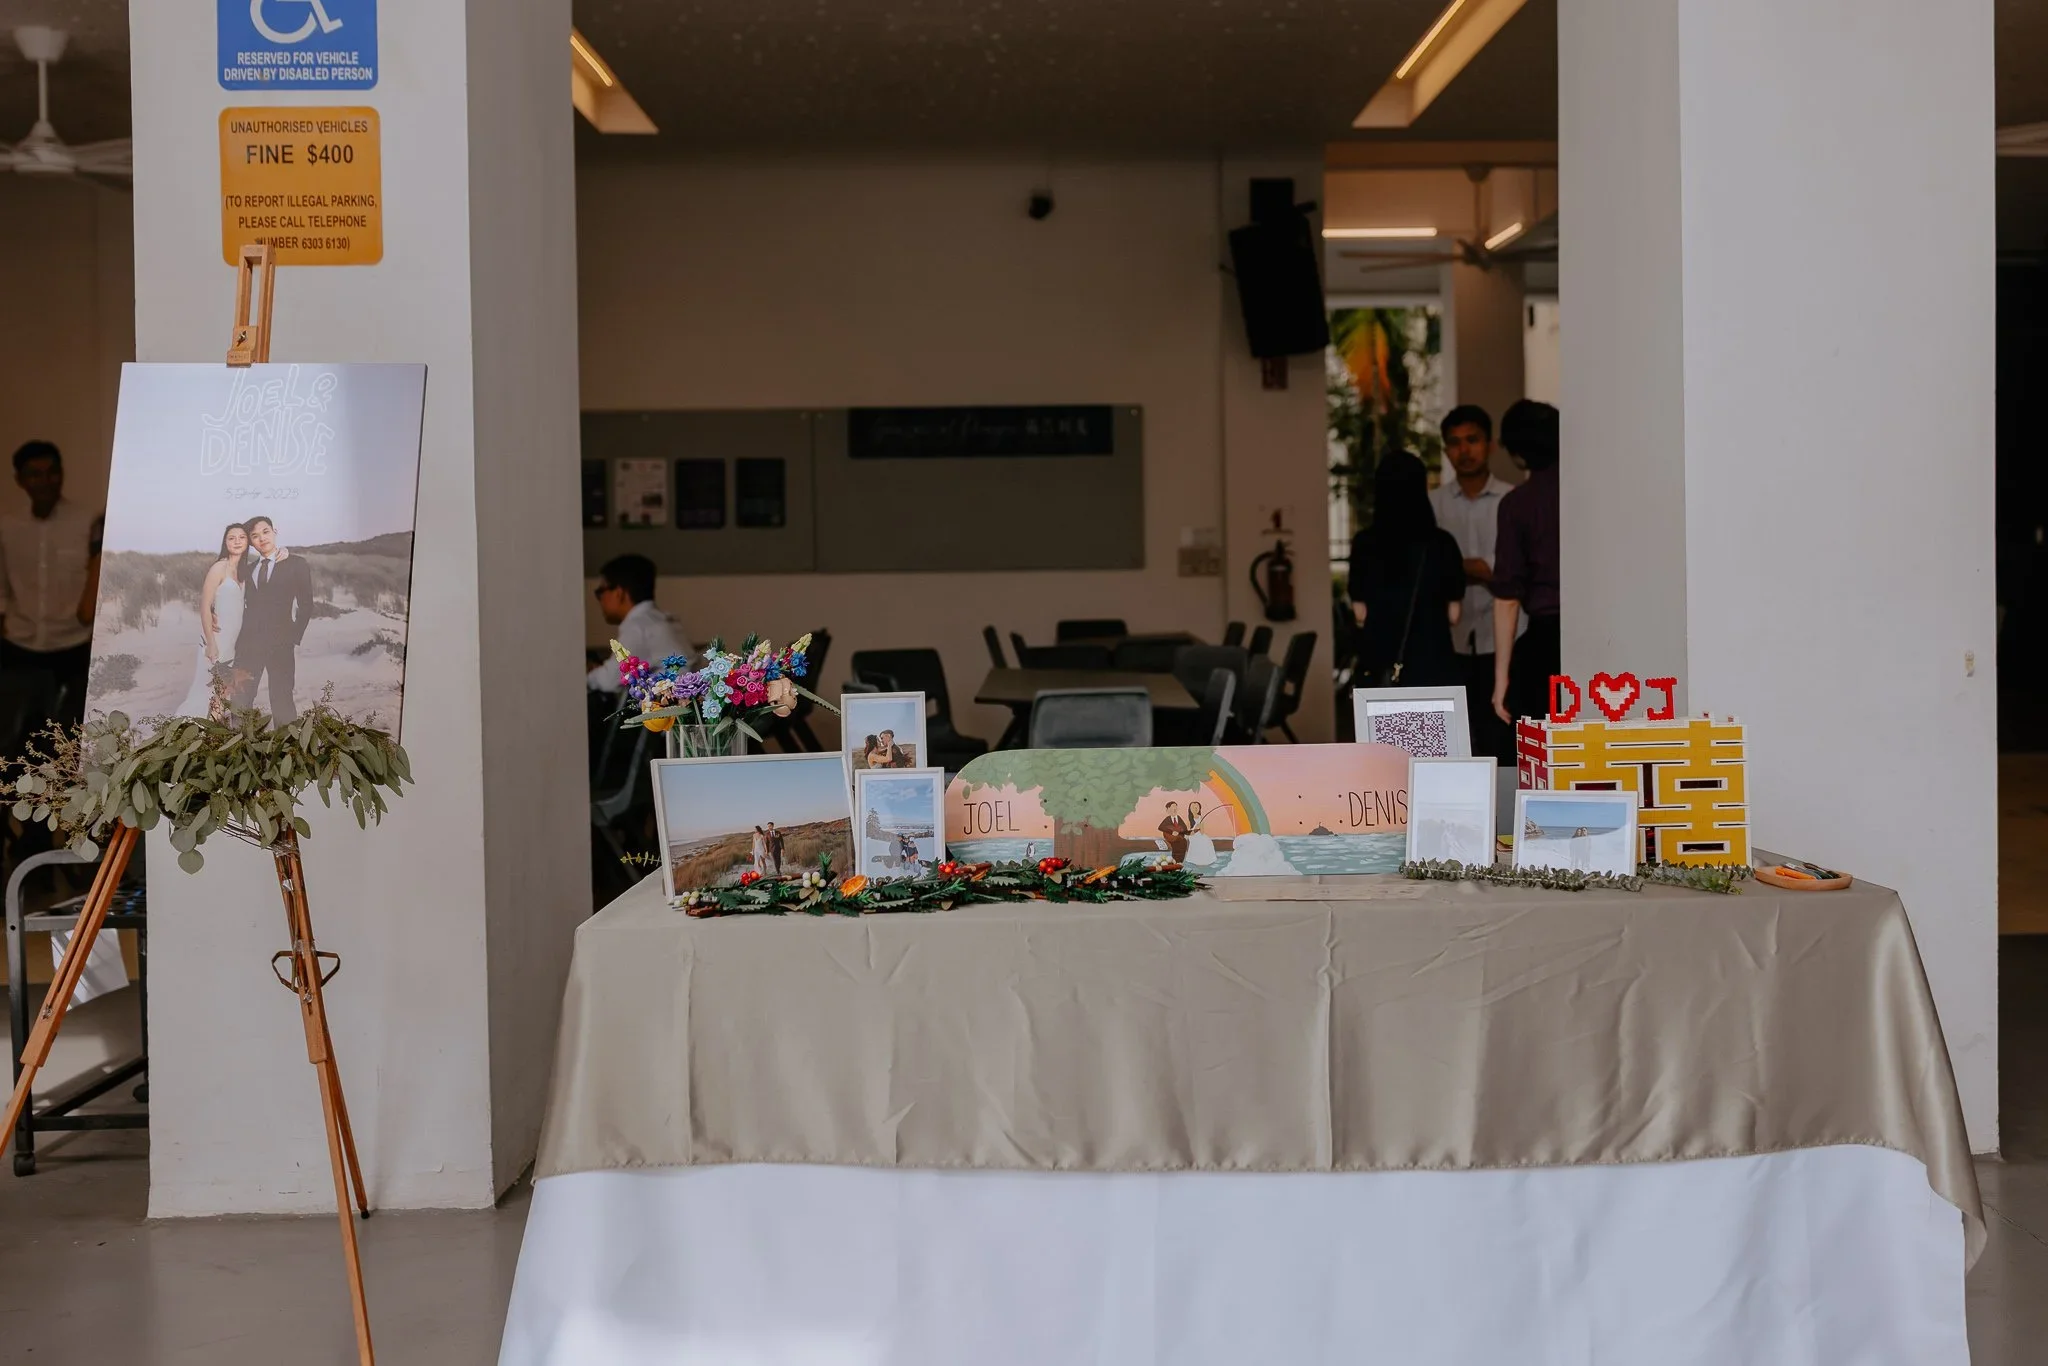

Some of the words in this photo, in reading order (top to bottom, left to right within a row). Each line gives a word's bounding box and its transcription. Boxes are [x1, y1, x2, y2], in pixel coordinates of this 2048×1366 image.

[237, 51, 291, 65] RESERVED
[293, 51, 315, 65] FOR
[316, 51, 359, 65] VEHICLE
[224, 67, 261, 81] DRIVEN
[263, 67, 277, 81] BY
[279, 67, 329, 81] DISABLED
[331, 67, 373, 81] PERSON
[230, 120, 314, 134] UNAUTHORISED
[316, 120, 369, 134] VEHICLES
[246, 144, 294, 165] FINE
[307, 143, 354, 166] $400
[225, 195, 242, 210] (TO
[244, 195, 285, 208] REPORT
[287, 194, 329, 208] ILLEGAL
[331, 194, 378, 209] PARKING,
[238, 215, 277, 229] PLEASE
[279, 215, 305, 229] CALL
[308, 215, 367, 228] TELEPHONE
[301, 237, 324, 250] 6303
[325, 237, 351, 251] 6130)
[200, 406, 336, 476] DENISE
[1349, 789, 1408, 827] DENIS
[963, 800, 1021, 835] JOEL
